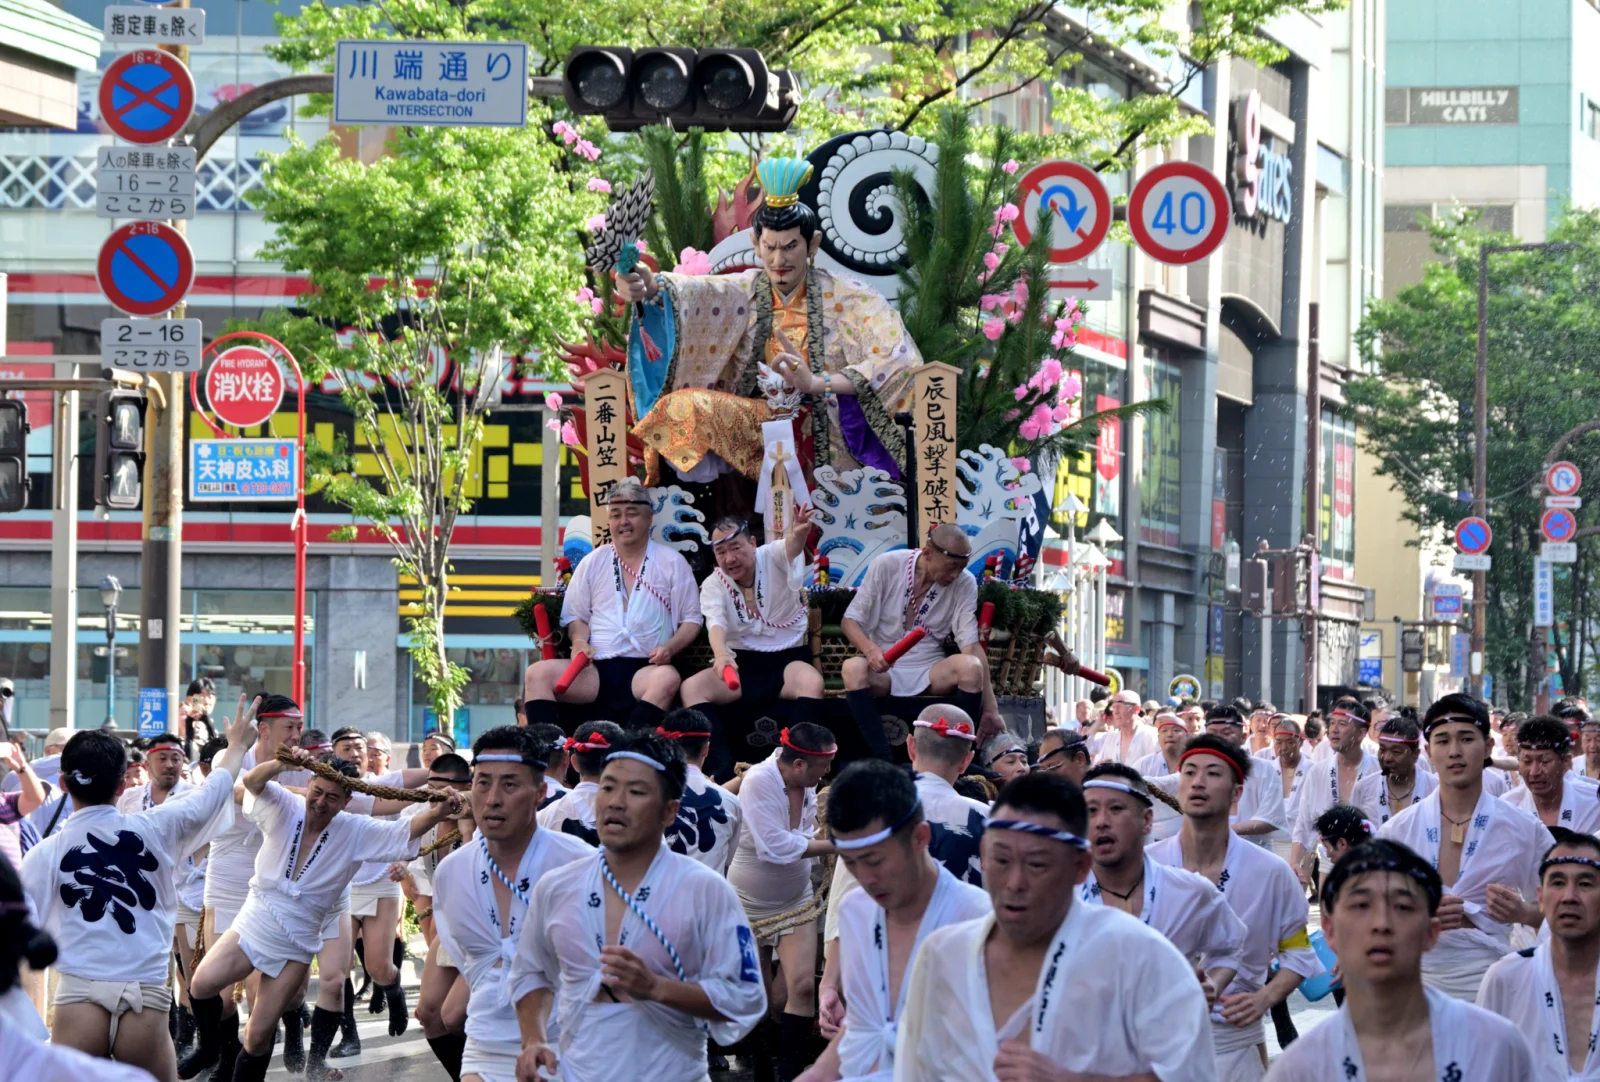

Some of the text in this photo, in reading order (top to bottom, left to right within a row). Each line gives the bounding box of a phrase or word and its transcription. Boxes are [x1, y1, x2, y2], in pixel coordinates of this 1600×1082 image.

[111, 14, 197, 36] 指定車を除く
[349, 50, 511, 81] 川端通り
[375, 86, 486, 102] Kawabata-dori
[387, 105, 473, 117] INTERSECTION
[1442, 107, 1487, 122] CATS
[102, 151, 191, 169] 人の降車を除く
[1244, 88, 1293, 224] gates
[106, 197, 186, 214] ここから
[1152, 190, 1206, 235] 40
[113, 350, 190, 367] ここから
[220, 359, 268, 369] FIRE HYDRANT
[214, 372, 275, 402] 消火栓
[594, 384, 618, 468] 二番山笠
[922, 376, 954, 534] 辰巳風撃破赤
[199, 459, 290, 480] 天神皮ふ科
[141, 711, 164, 729] 2m
